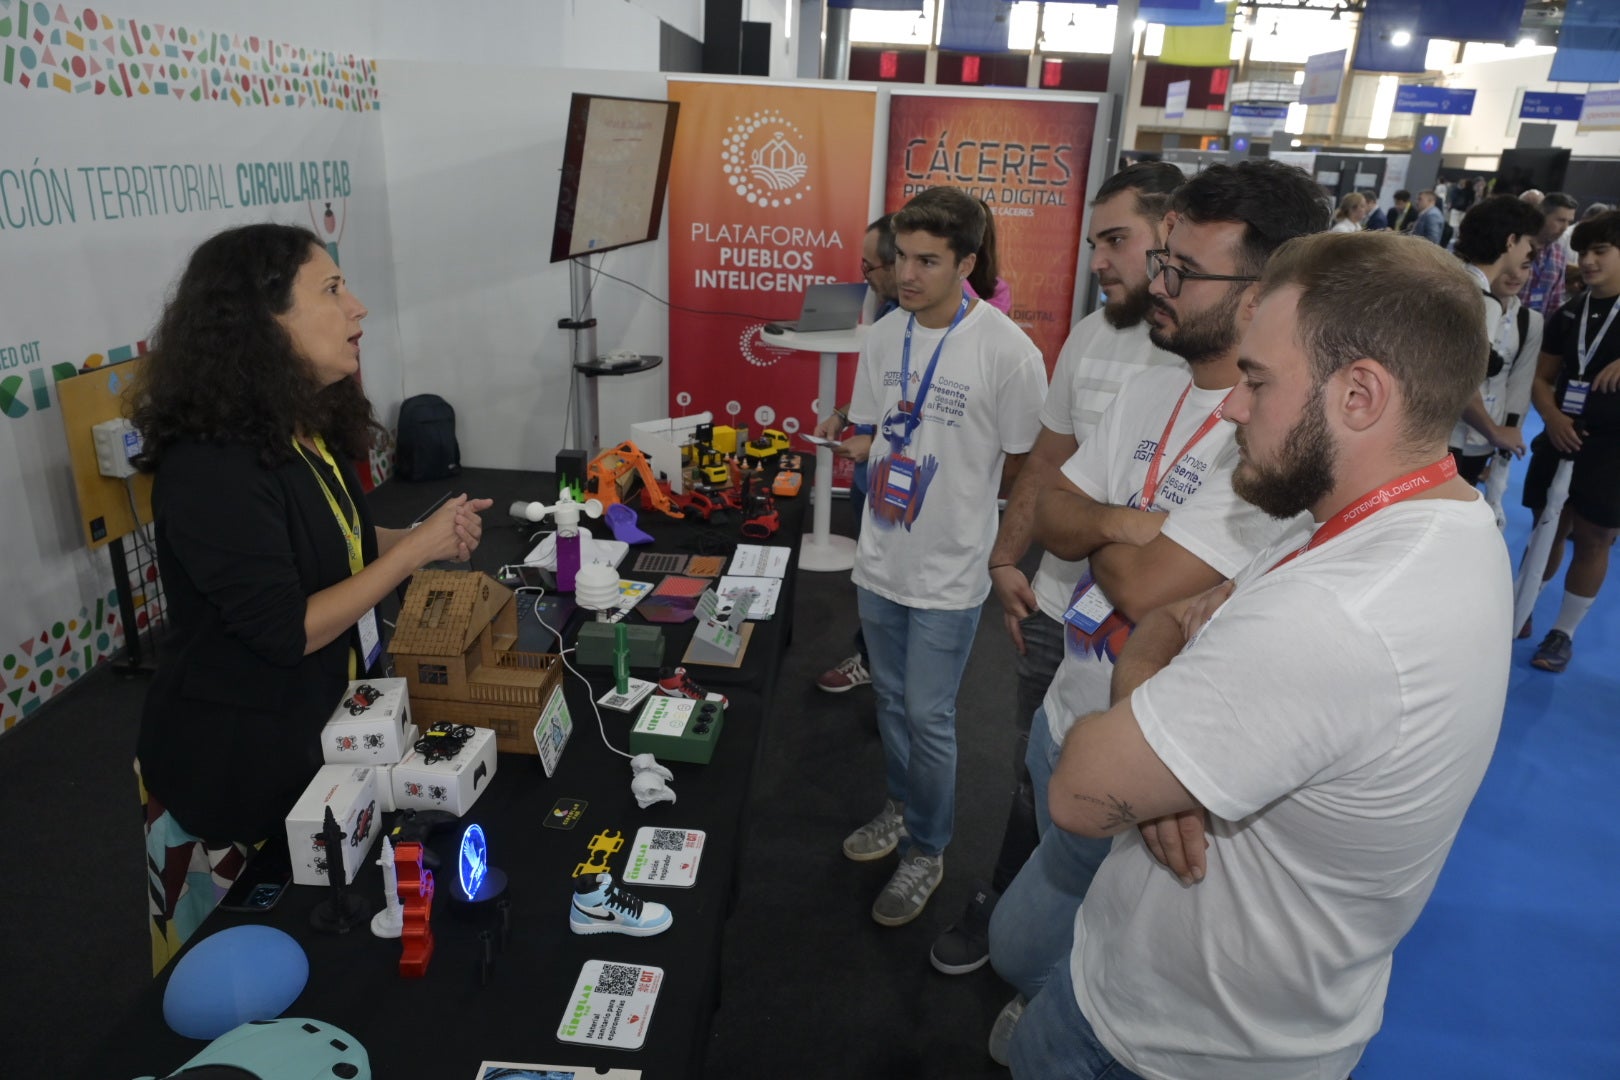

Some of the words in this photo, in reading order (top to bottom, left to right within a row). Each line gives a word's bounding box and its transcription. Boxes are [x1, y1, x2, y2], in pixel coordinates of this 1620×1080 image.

[905, 131, 1073, 186] CÁCERES
[0, 157, 76, 230] CIÓN
[77, 163, 234, 222] TERRITORIAL
[235, 161, 321, 208] CIRCULAR
[321, 159, 351, 201] FAB
[1001, 187, 1067, 207] DIGITAL
[691, 222, 844, 249] PLATAFORMA
[720, 246, 814, 271] PUEBLOS
[1013, 310, 1056, 322] DIGITAL
[0, 348, 19, 370] ED
[20, 341, 40, 365] CIT
[938, 376, 970, 392] Conoce
[936, 403, 964, 417] Futuro
[566, 984, 593, 1037] CIRCULAR
[597, 1013, 611, 1040] sanitario
[606, 999, 616, 1014] para
[586, 1013, 601, 1039] Material
